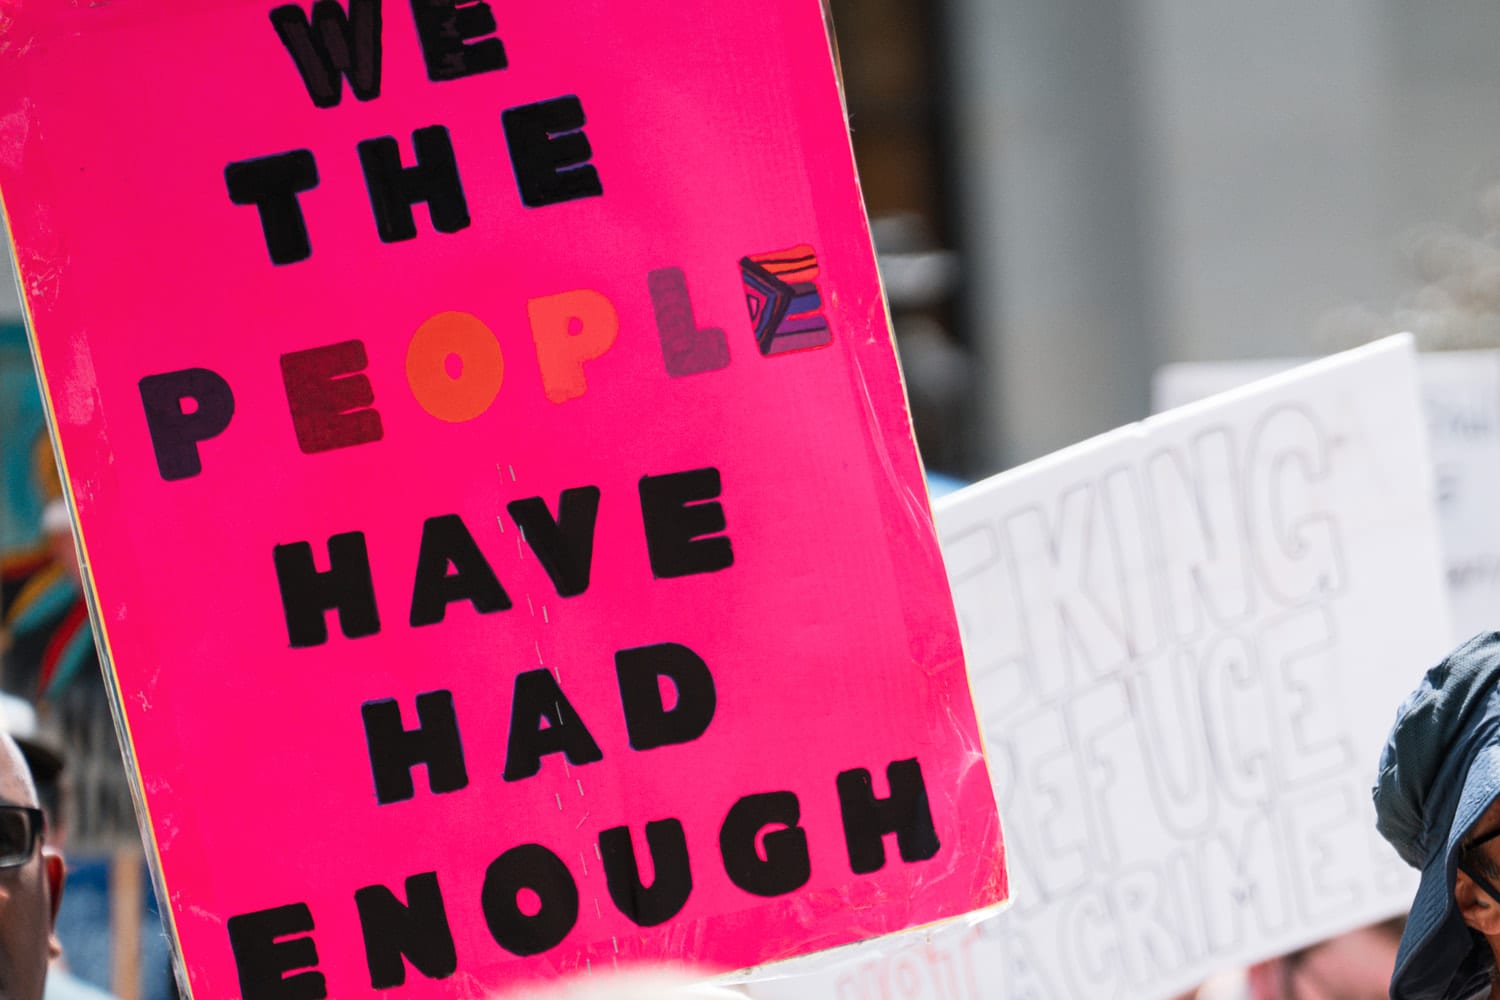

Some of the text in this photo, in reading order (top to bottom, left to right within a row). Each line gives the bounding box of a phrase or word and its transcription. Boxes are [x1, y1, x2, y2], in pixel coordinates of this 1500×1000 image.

[270, 0, 508, 108] WE
[224, 94, 604, 265] THE
[138, 244, 833, 481] PEOPLE
[272, 466, 734, 648] HAVE
[360, 642, 716, 804] HAD
